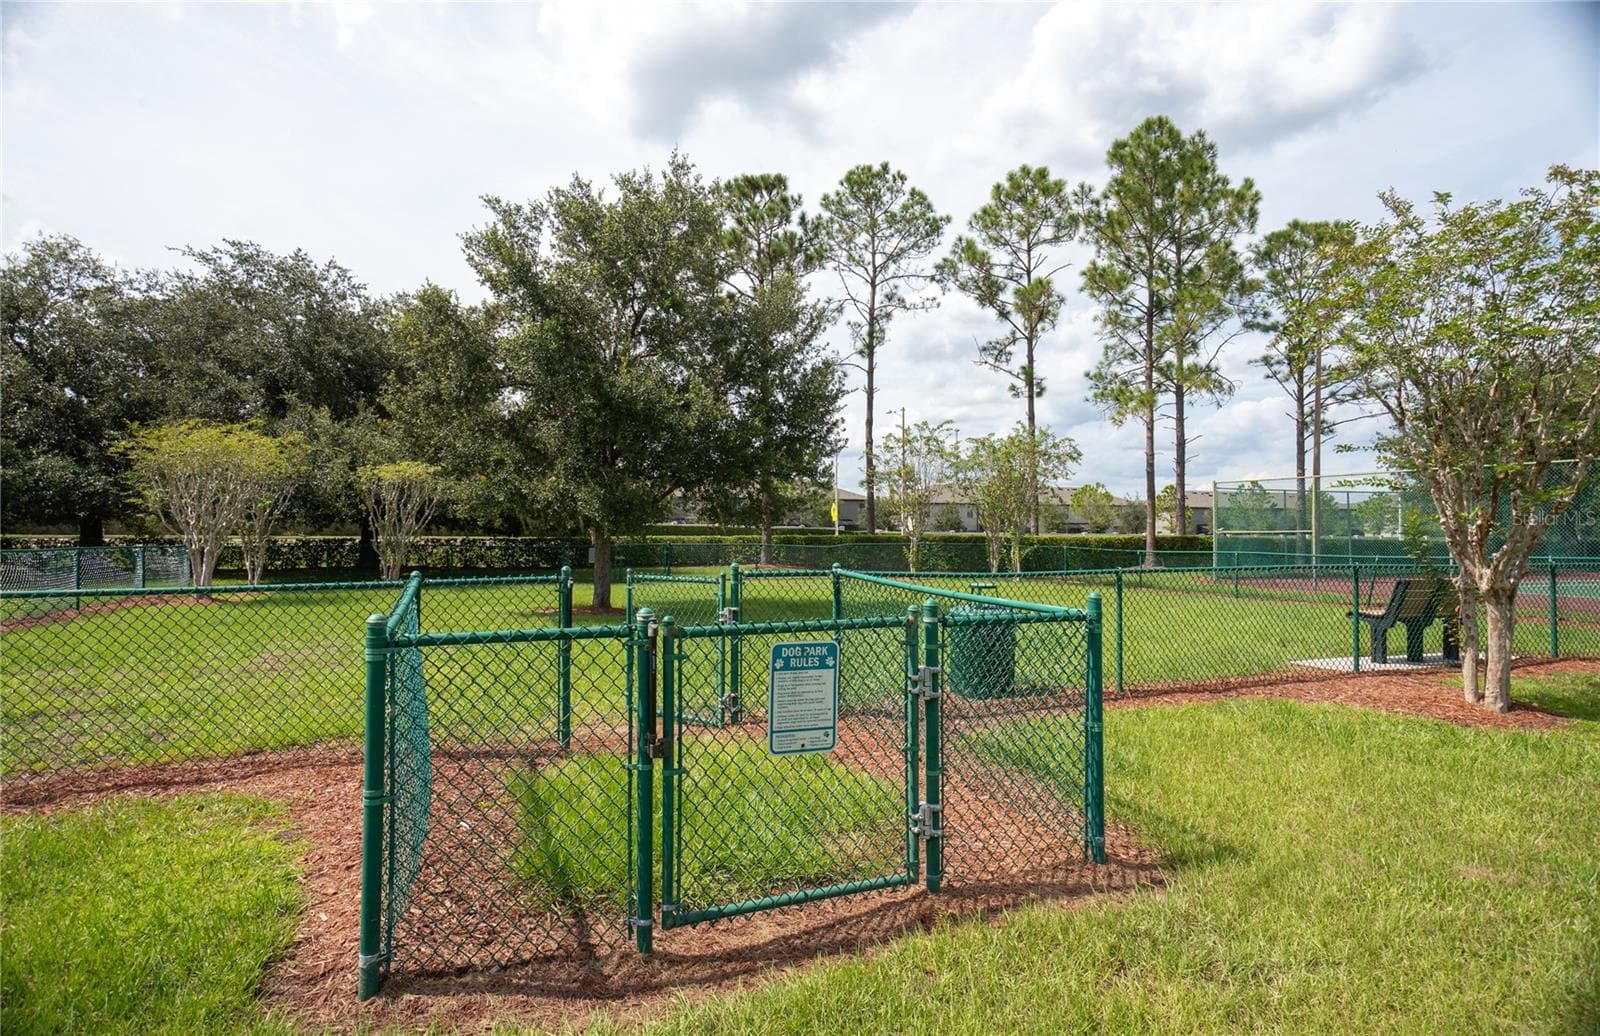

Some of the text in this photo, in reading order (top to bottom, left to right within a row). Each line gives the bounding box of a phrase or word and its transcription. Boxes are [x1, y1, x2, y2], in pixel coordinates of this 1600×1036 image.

[782, 646, 828, 657] DOG PARK
[790, 657, 820, 667] RULES
